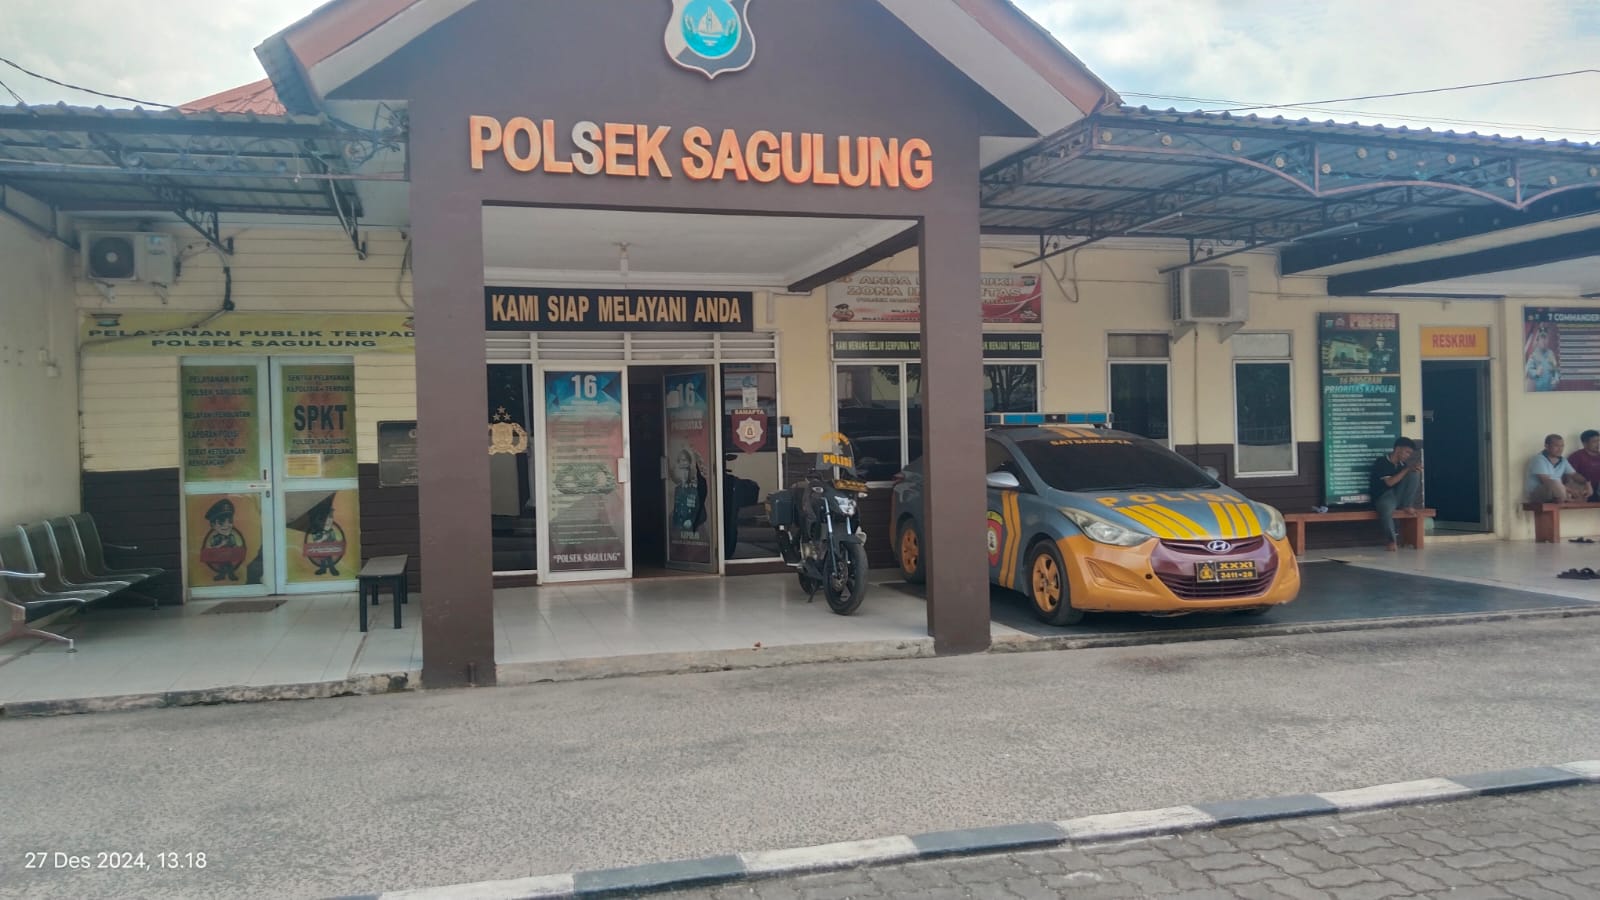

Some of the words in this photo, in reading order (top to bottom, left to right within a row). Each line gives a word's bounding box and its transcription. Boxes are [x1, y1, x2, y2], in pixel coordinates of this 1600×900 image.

[469, 115, 672, 178] POLSEK
[681, 126, 933, 190] SAGULUNG
[491, 294, 540, 322] KAMI
[547, 295, 590, 323] SIAP
[598, 295, 687, 323] MELAYANI
[694, 297, 742, 323] ANDA
[151, 339, 243, 347] POLSEK
[1432, 334, 1477, 348] RESKRIM
[571, 375, 597, 399] 16
[676, 382, 696, 407] 16
[294, 404, 348, 431] SPKT
[1096, 492, 1242, 506] POLISI
